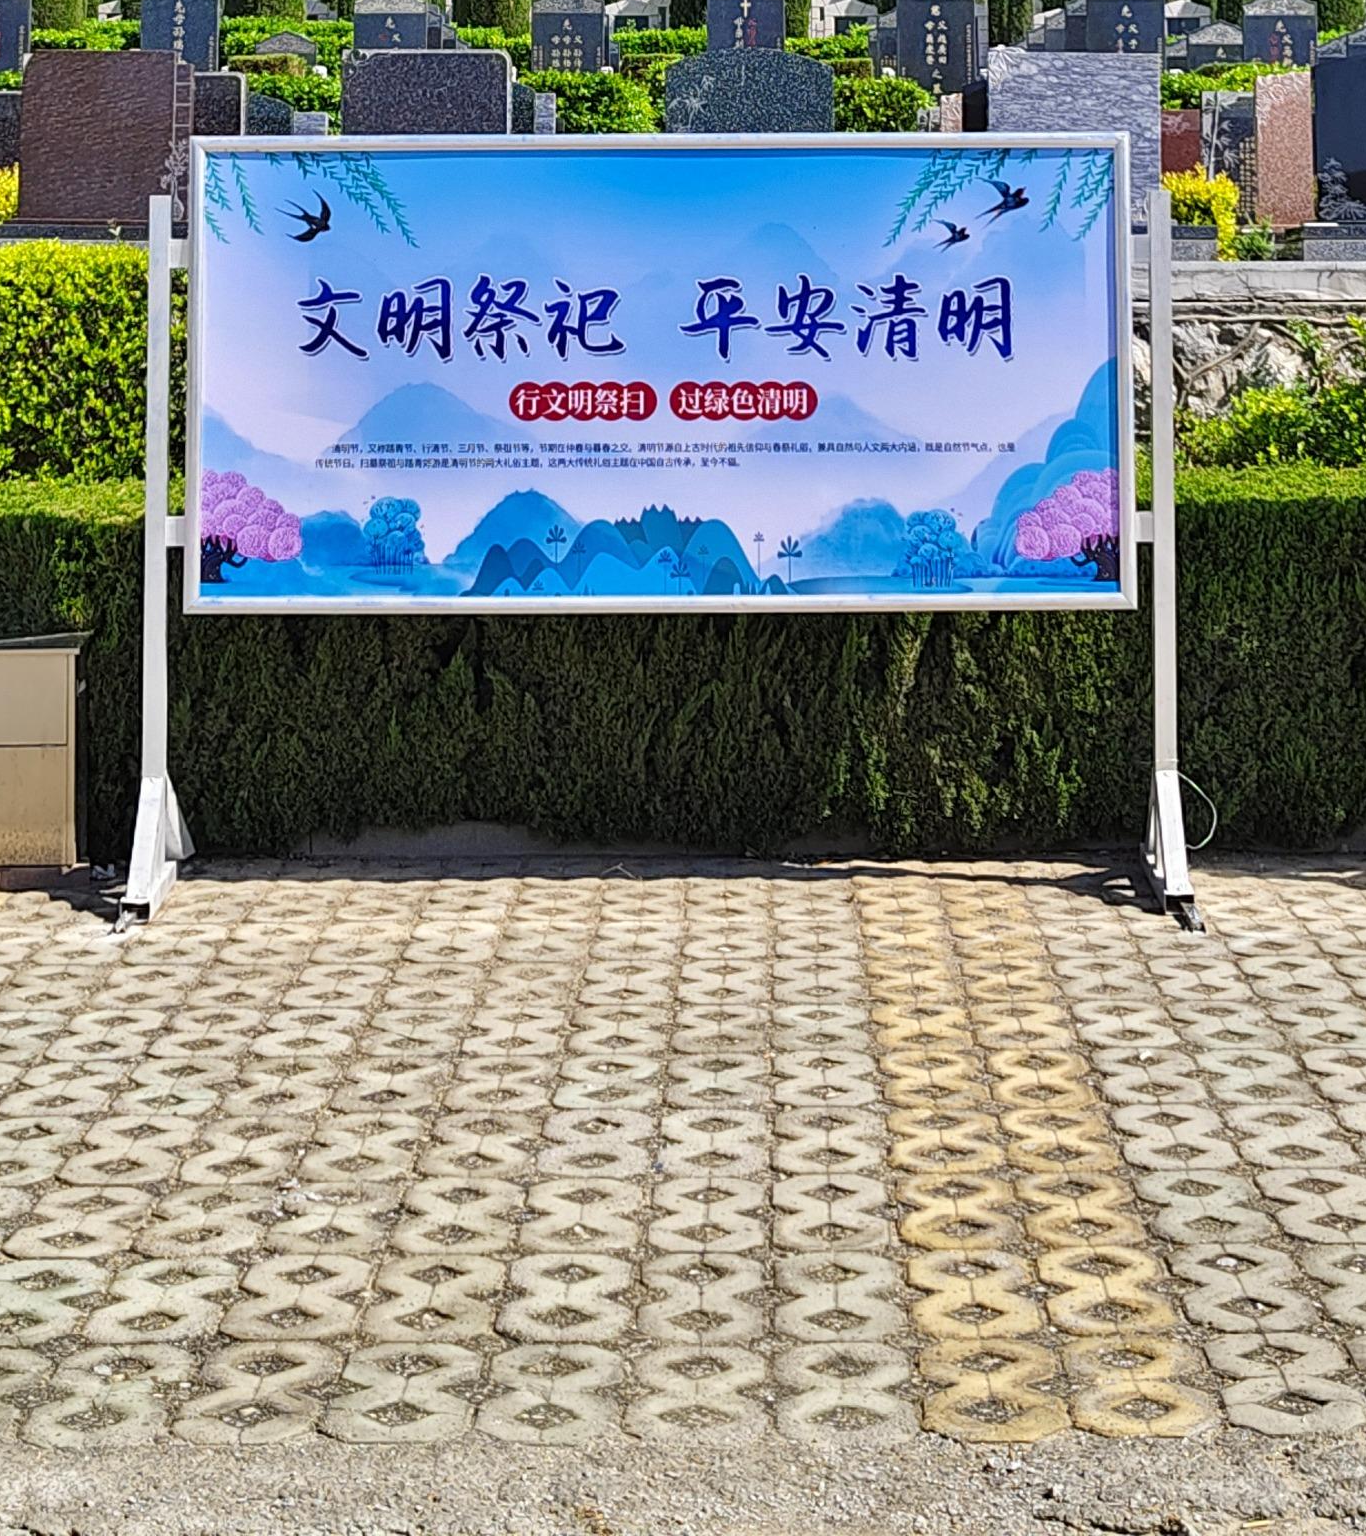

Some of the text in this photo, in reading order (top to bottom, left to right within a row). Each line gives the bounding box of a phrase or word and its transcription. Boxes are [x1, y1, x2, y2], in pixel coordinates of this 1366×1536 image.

[297, 272, 1016, 363] 文明祭祀 平安清明
[514, 386, 811, 418] 行文明祭扫 过绿色清明
